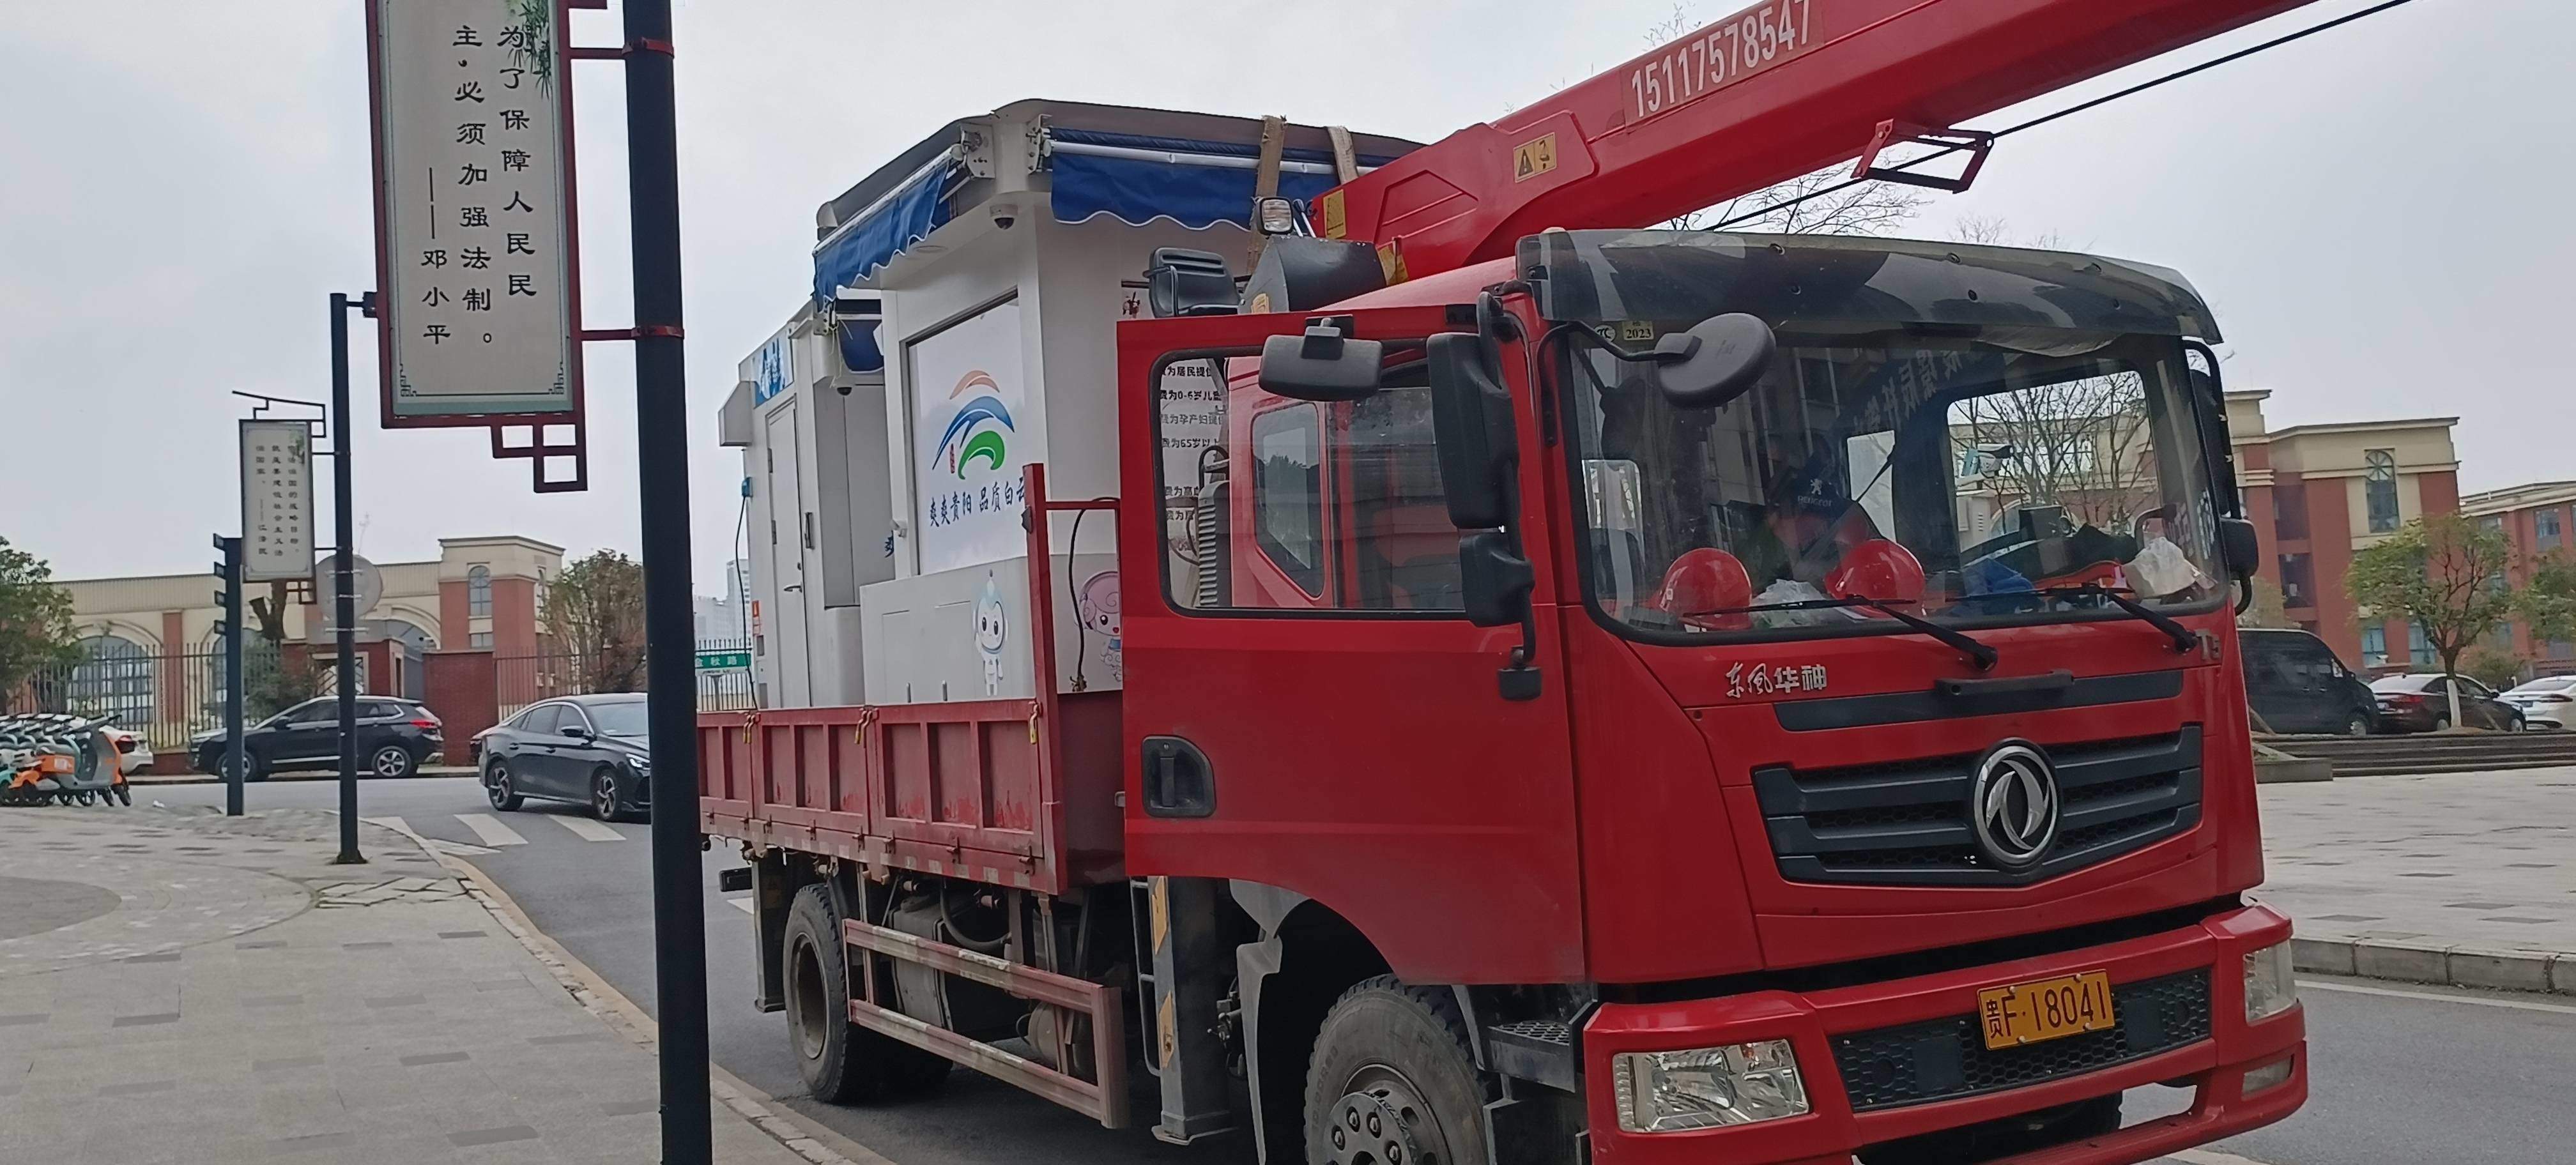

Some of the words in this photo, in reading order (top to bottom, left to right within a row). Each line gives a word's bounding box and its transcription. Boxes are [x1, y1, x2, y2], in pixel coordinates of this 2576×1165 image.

[1631, 0, 1809, 118] 15117578547
[496, 24, 537, 298] 为了保障人民民
[1625, 328, 1652, 339] 2023
[1163, 366, 1211, 377] 为居民提
[1726, 661, 1827, 698] 东风华神
